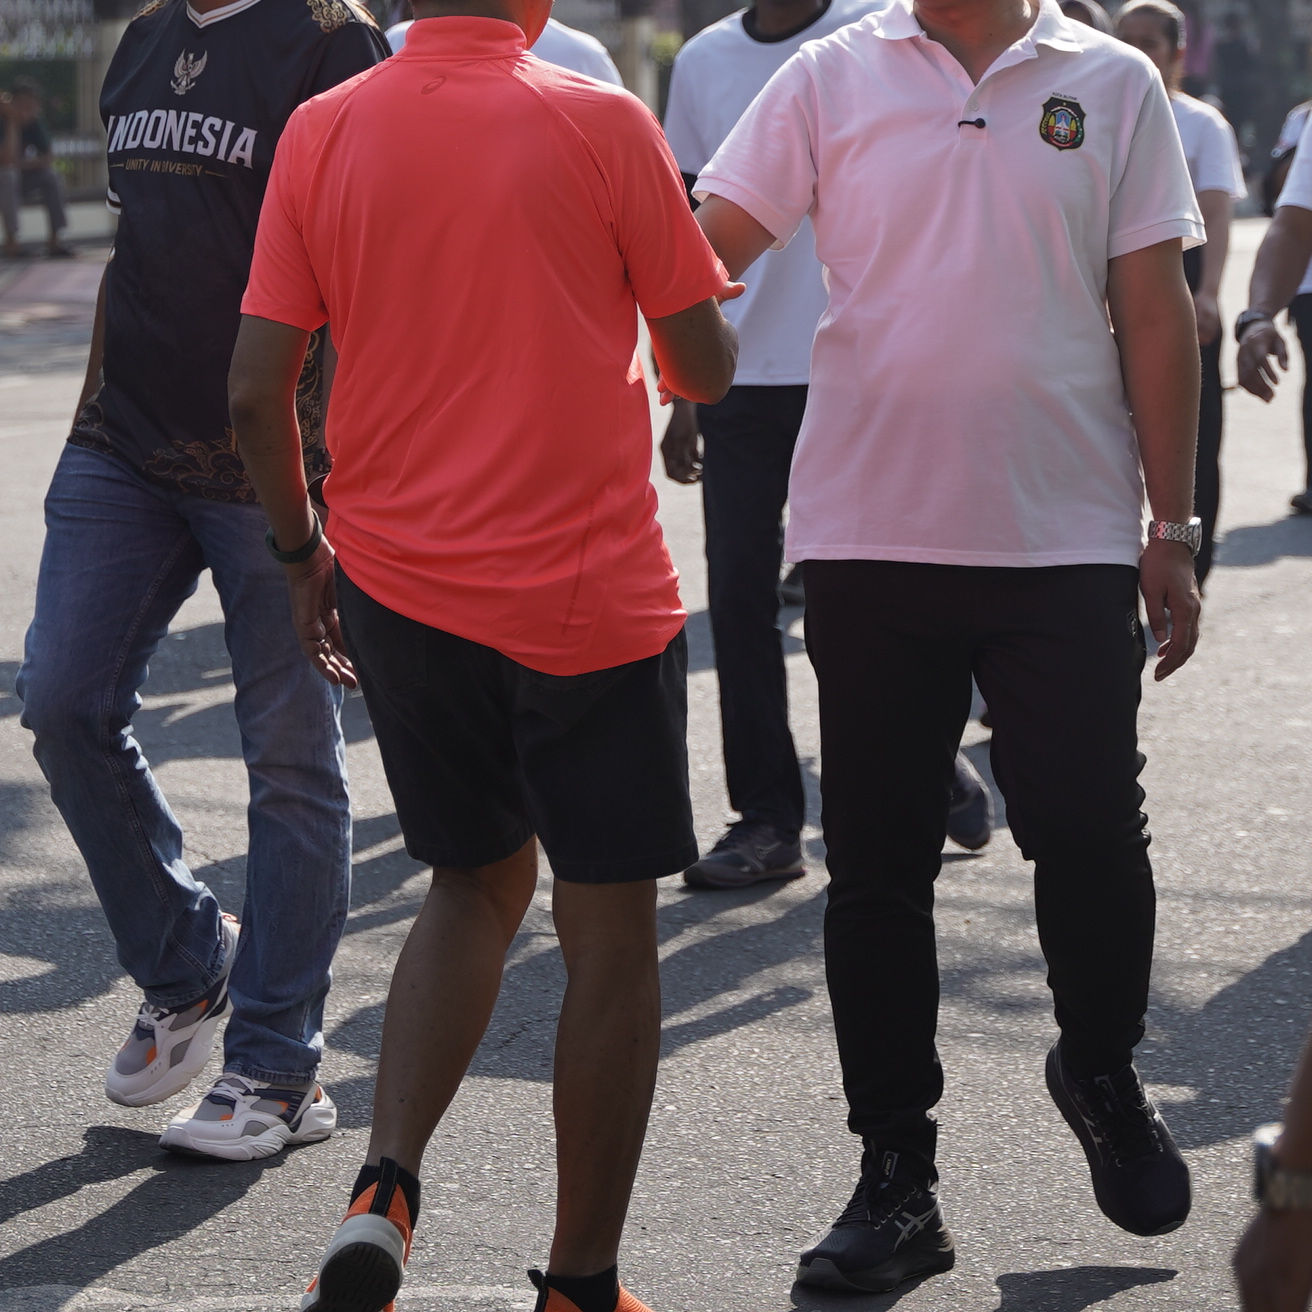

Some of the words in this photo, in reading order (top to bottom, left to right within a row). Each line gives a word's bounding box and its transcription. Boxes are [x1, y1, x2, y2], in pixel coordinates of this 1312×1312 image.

[108, 109, 258, 170] INDONESIA
[125, 158, 150, 171] UNITY
[150, 160, 161, 172] IN
